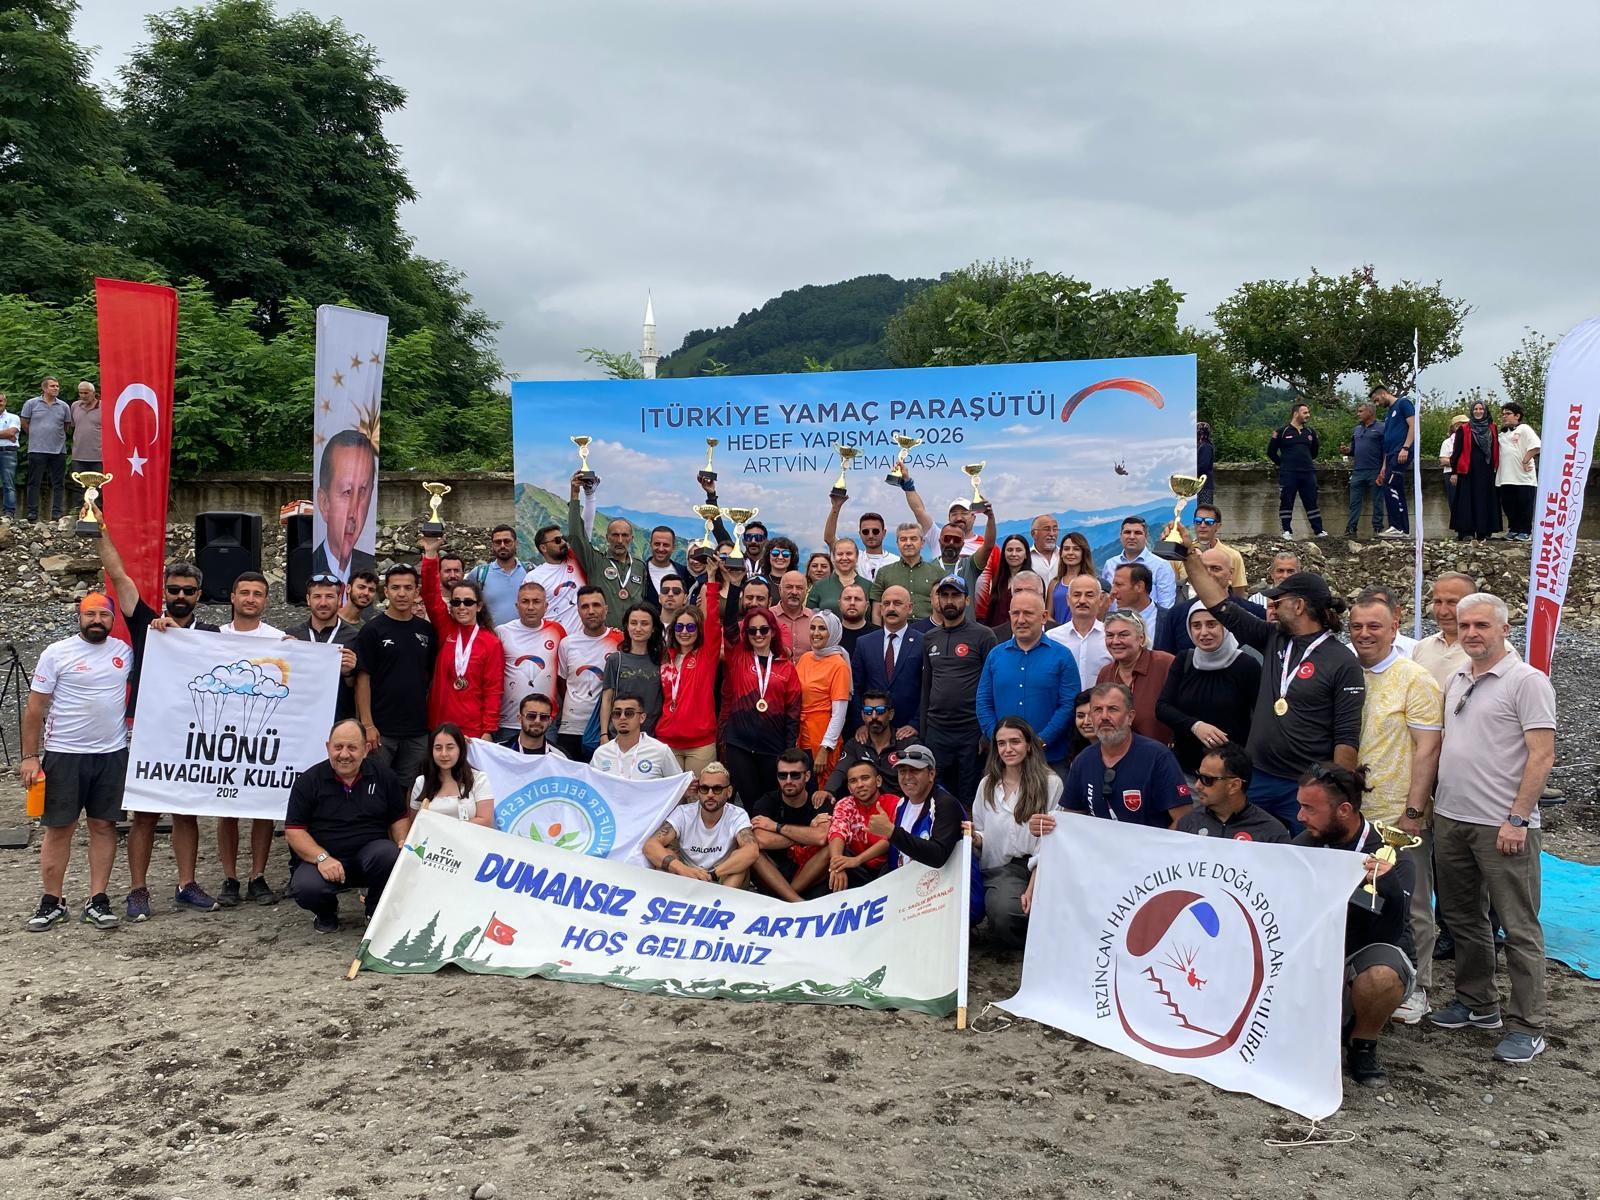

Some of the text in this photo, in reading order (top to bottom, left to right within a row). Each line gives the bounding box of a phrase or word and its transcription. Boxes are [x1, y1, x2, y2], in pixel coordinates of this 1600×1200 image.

[779, 401, 879, 425] YAMAÇ
[728, 433, 793, 451] HEDEF
[915, 427, 964, 444] 2026
[743, 452, 817, 473] ARTVİN
[848, 453, 949, 471] EMALPAŞA
[1548, 403, 1583, 594] HAVA SPORLARI
[1556, 451, 1587, 598] FEDERASYONU
[1536, 492, 1559, 591] TÜRKİYE
[185, 722, 280, 765] İNÖNÜ
[136, 761, 304, 788] HAVACILIK KULÜ
[216, 787, 239, 799] 2012
[426, 852, 462, 869] ARTVİN
[440, 846, 454, 857] T.C.
[474, 852, 888, 938] DUMANSIZ ŞEHİR ARTVİN'E
[561, 926, 772, 966] HOŞ GELDİNİZ
[1092, 861, 1285, 1065] ERZİNCAN HAVACILIK VE DOĞA SPORLARI KULÜBÜ
